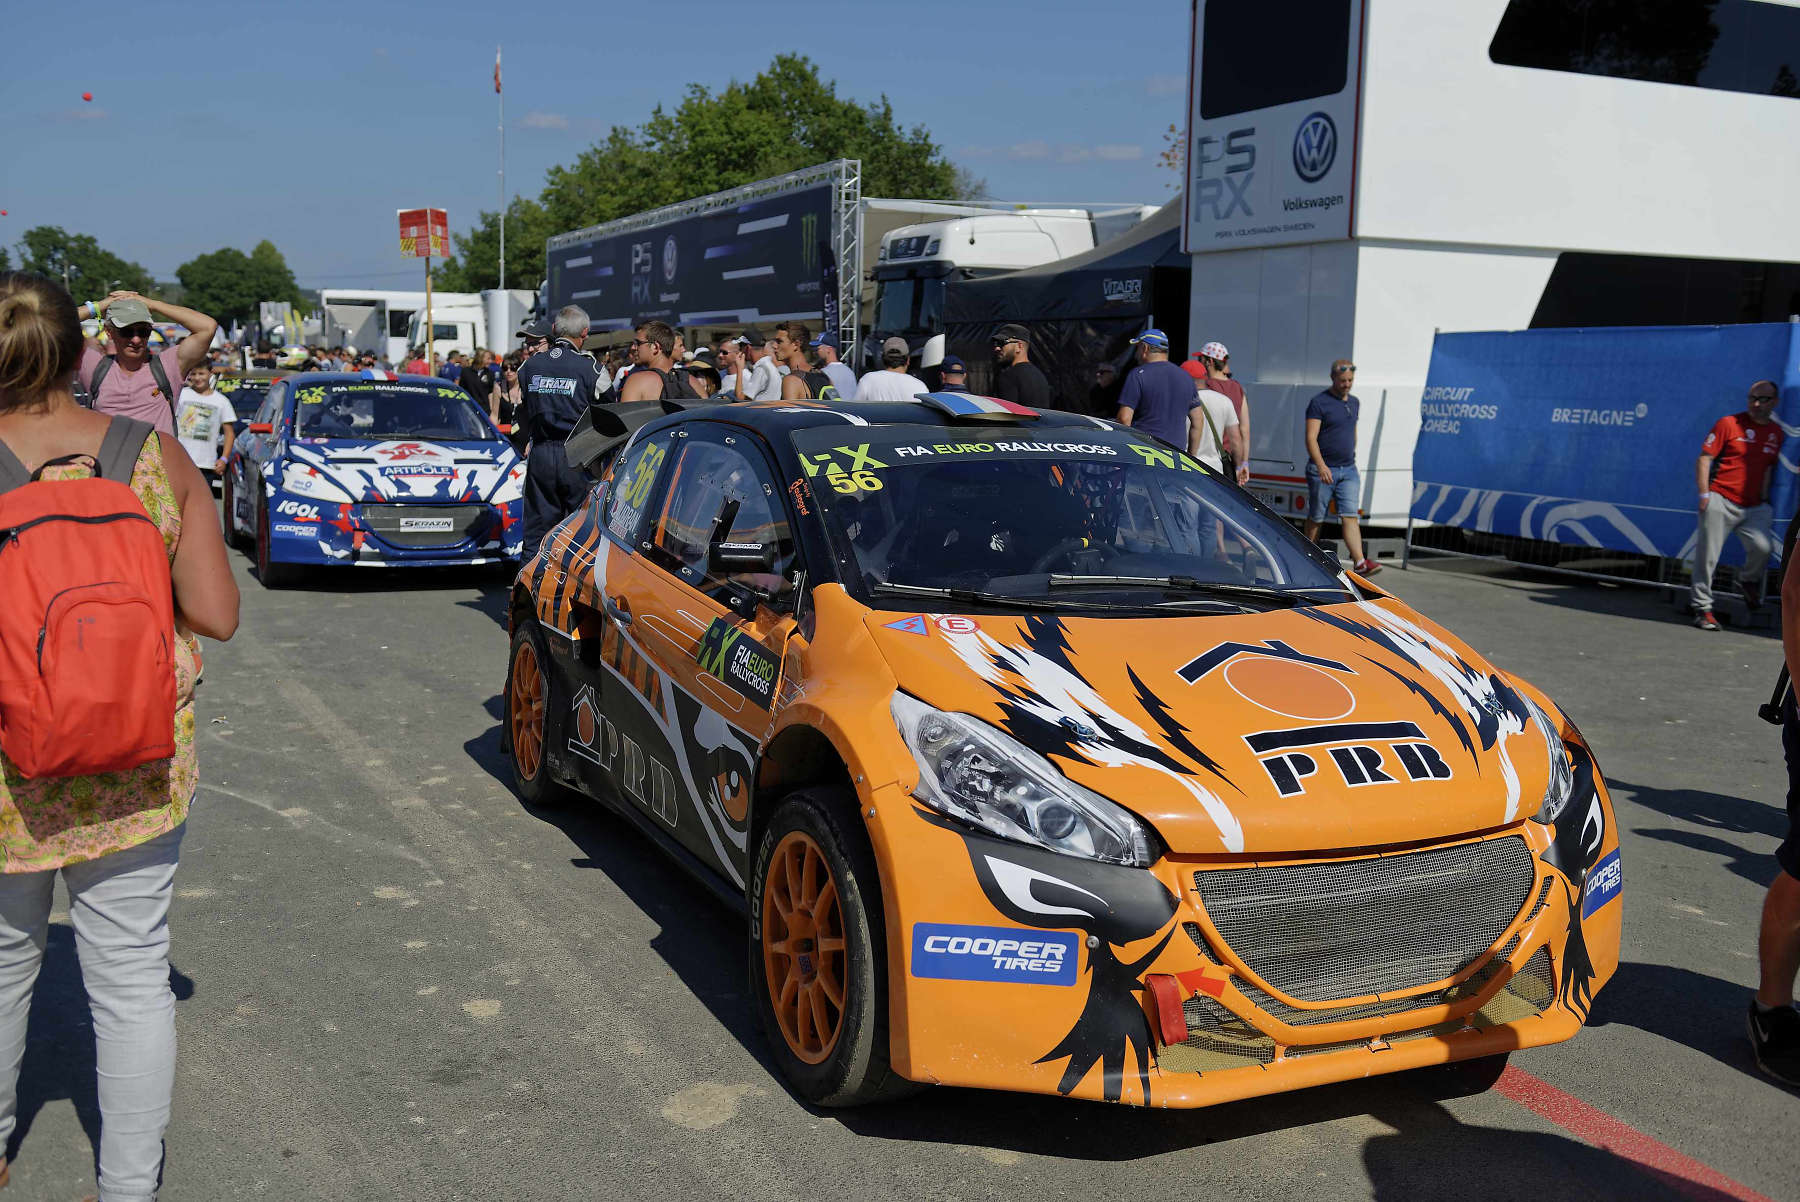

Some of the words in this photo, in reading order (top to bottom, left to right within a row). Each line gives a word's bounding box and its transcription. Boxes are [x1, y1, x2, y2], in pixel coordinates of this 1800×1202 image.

[1283, 195, 1344, 211] Volkswagen
[375, 384, 429, 394] RALLYCROSS
[528, 375, 577, 398] SERAZIN
[1424, 386, 1475, 401] CIRCUIT
[1421, 403, 1498, 420] RALLYCROSS
[1551, 407, 1635, 427] BRETAGNE
[894, 444, 934, 458] FIA
[932, 443, 995, 455] EURO
[995, 442, 1118, 456] RALLYCROSS
[624, 441, 666, 509] 56
[825, 470, 884, 494] 56
[276, 500, 319, 519] IGOL
[275, 525, 317, 534] COOPER
[730, 660, 770, 696] RALLYCROSS
[599, 713, 678, 828] PRB
[1258, 742, 1453, 798] PRB
[1586, 858, 1621, 897] COOPER
[1601, 872, 1621, 895] TIRES
[923, 935, 1067, 961] COOPER
[991, 956, 1063, 973] TIRES
